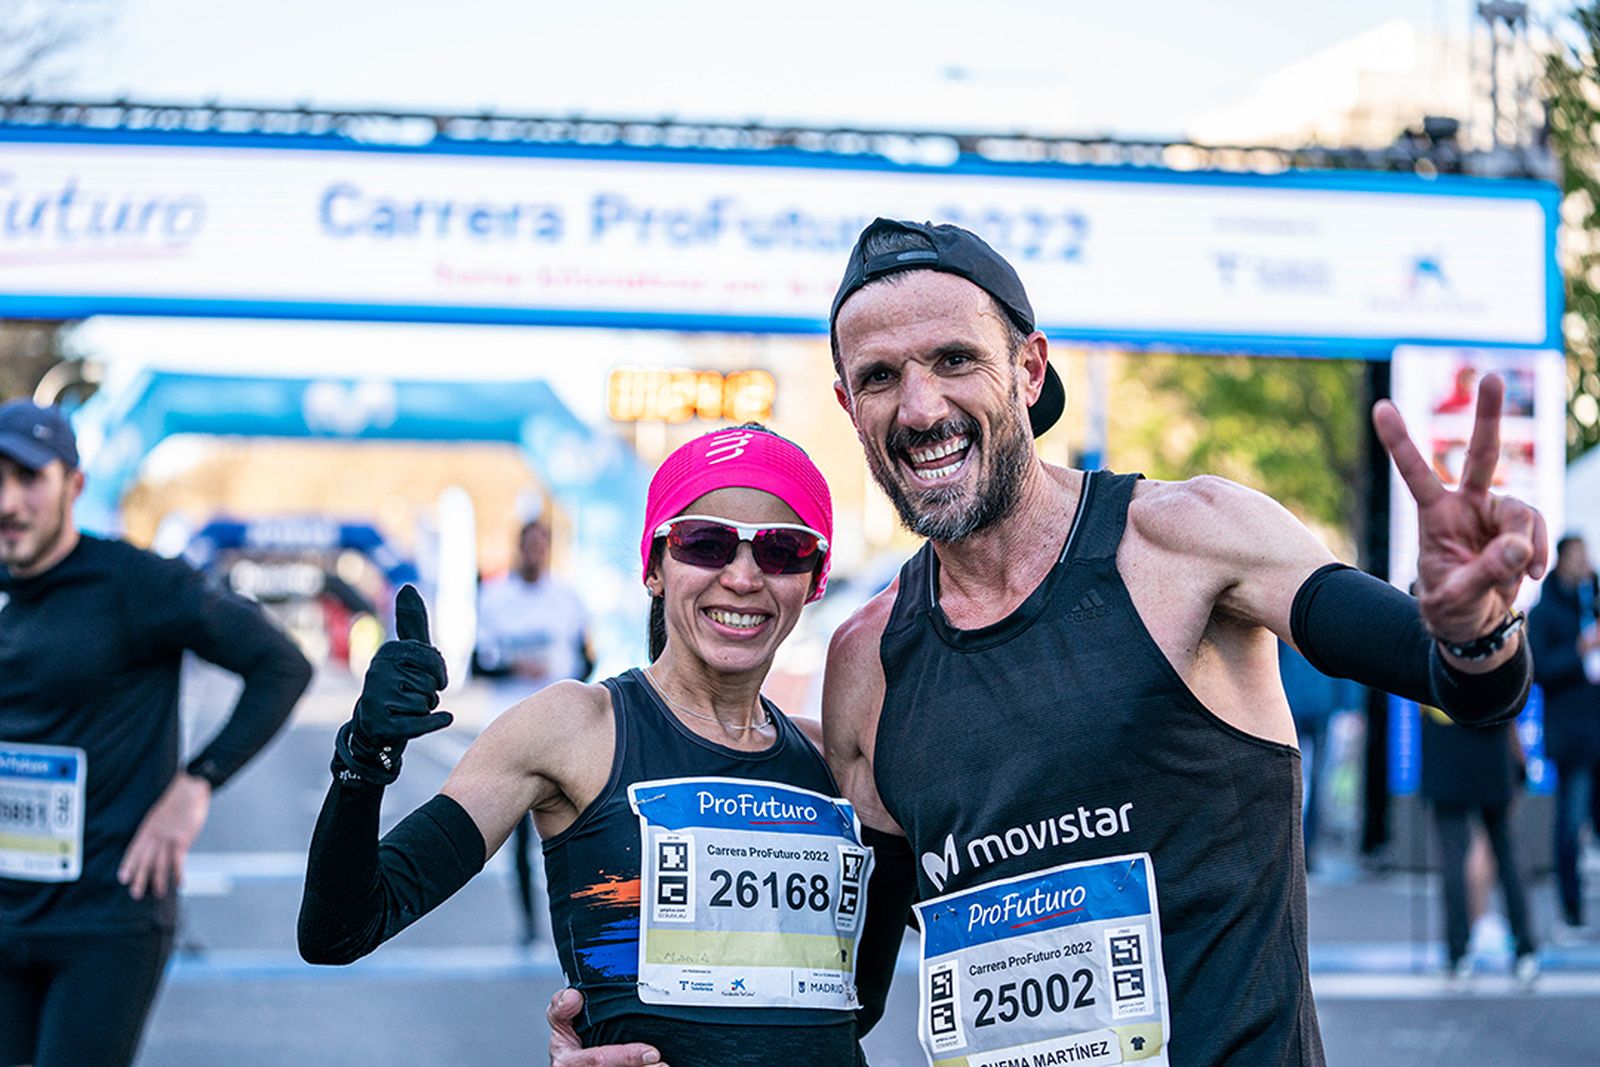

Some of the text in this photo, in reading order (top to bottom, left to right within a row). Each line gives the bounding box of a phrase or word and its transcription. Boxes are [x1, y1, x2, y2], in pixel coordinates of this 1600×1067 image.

[317, 181, 565, 243] Carrera
[697, 791, 818, 822] ProFuturo
[707, 844, 830, 862] Carrera ProFuturo 2022
[967, 802, 1133, 868] movistar
[708, 869, 831, 912] 26168
[968, 886, 1087, 932] ProFuturo
[969, 941, 1093, 977] Carrera ProFuturo 2022
[810, 982, 844, 994] MADRID
[973, 968, 1096, 1028] 25002
[1033, 1040, 1110, 1067] MARTÍNEZ
